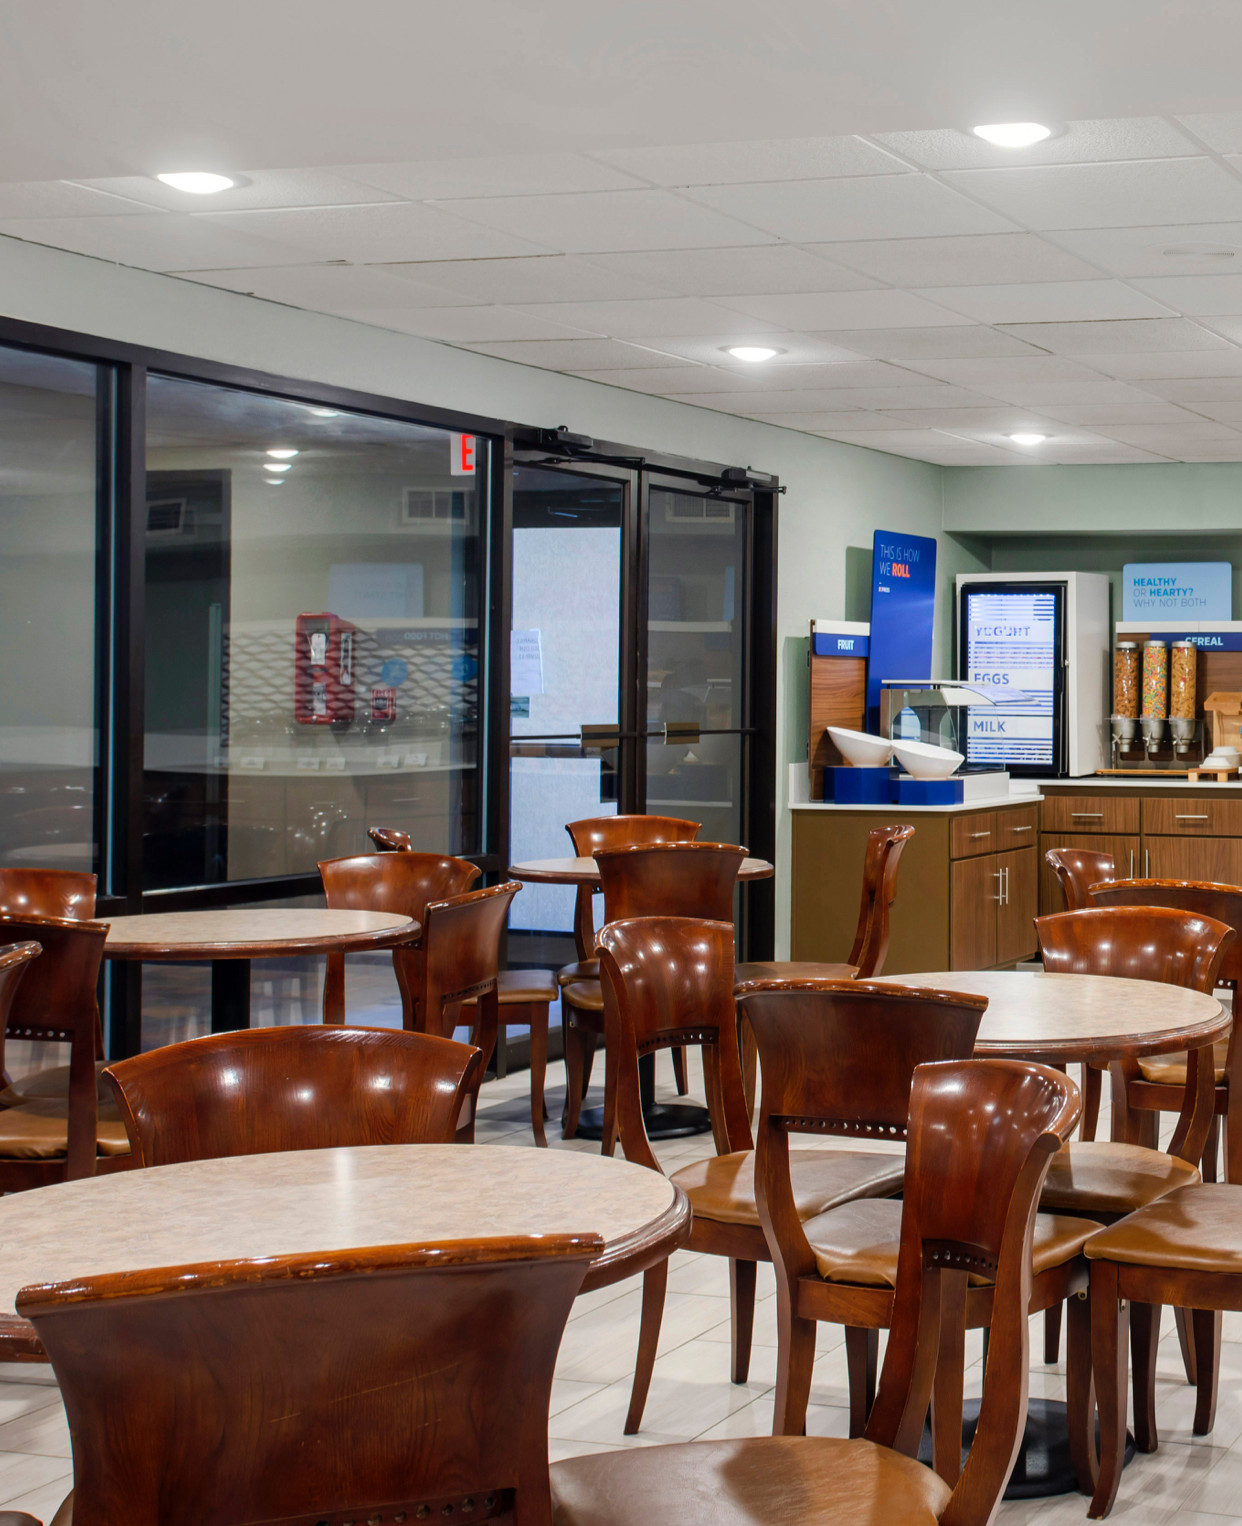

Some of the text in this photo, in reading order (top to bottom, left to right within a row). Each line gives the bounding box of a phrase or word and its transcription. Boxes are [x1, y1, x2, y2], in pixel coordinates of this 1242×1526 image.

[881, 544, 920, 562] THIS IS HOW
[880, 562, 910, 578] WE ROLL
[1133, 578, 1176, 586] HEALTHY
[1133, 588, 1194, 597] OR HEARTY?
[1134, 598, 1207, 608] WHY NOT BOTH
[838, 640, 854, 650] FRUIT
[974, 673, 1010, 684] EGGS
[973, 721, 1006, 732] MILK
